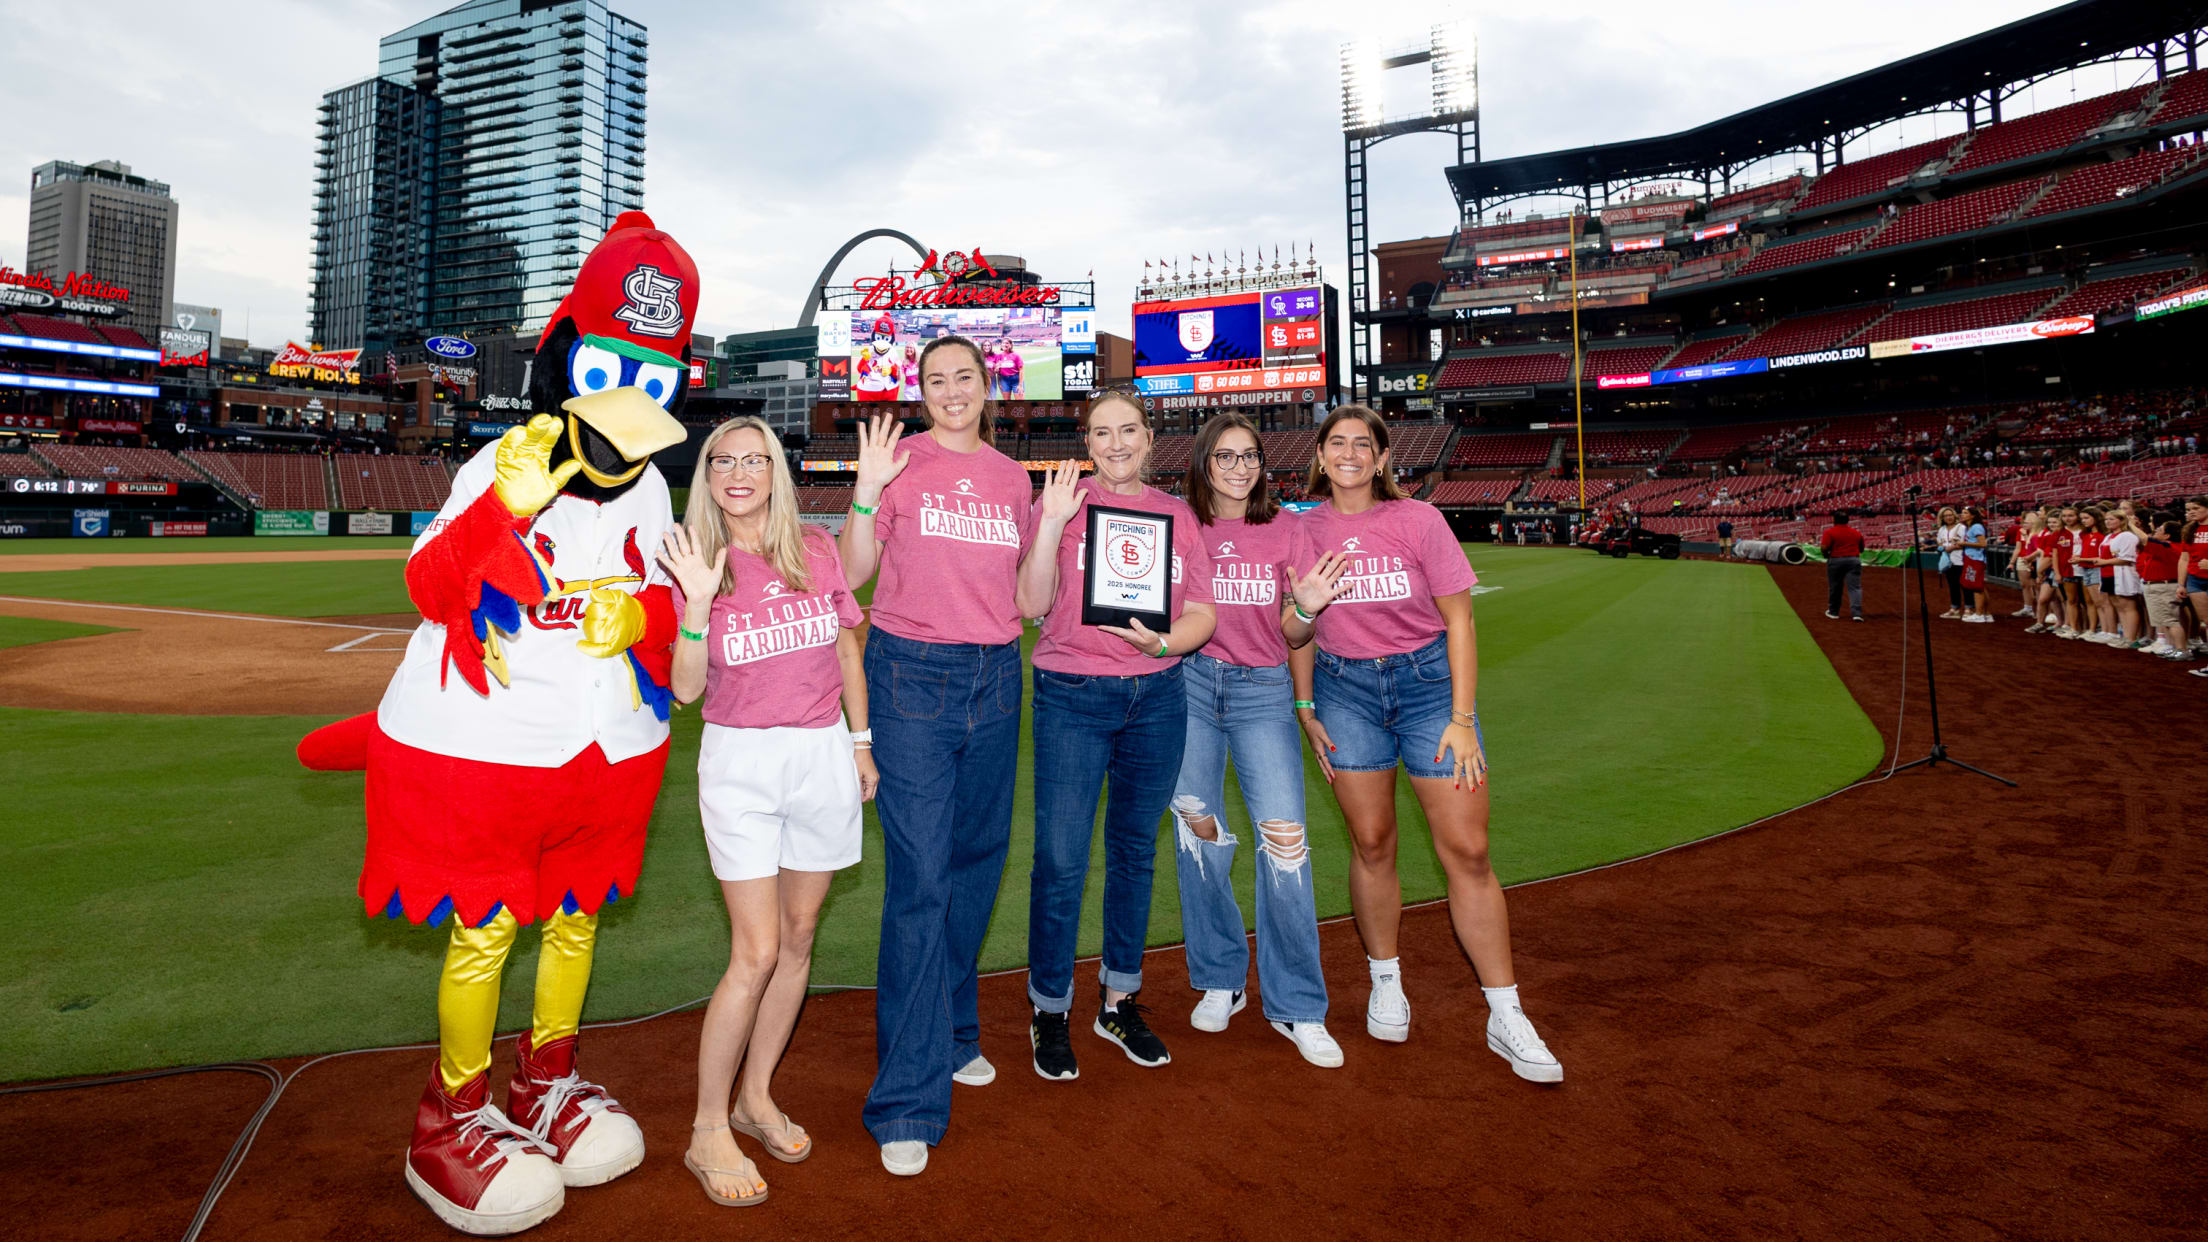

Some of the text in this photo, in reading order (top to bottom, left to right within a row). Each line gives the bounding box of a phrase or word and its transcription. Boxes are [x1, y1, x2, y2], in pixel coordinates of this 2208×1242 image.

[1630, 181, 1682, 193] BUDWEISER
[1637, 203, 1690, 215] BUDWEISER
[53, 272, 129, 301] Nation
[853, 276, 1060, 310] Budweiser
[1152, 272, 1303, 297] WORLD CHAMPIONS
[61, 300, 115, 315] ROOFTOP
[1472, 307, 1512, 317] @cardinals
[2138, 297, 2181, 316] TODAY'S
[160, 331, 209, 345] FANDUEL
[1935, 331, 1983, 343] DIERBERGS
[1984, 326, 2028, 338] DELIVERS
[436, 338, 467, 355] Ford
[160, 347, 209, 368] Live!
[274, 347, 360, 369] Budweiser
[1770, 346, 1866, 369] LINDENWOOD.EDU
[270, 363, 312, 381] BREW
[1064, 360, 1093, 380] stl
[1147, 379, 1181, 391] STIFEL
[1163, 391, 1292, 408] BROWN & CROUPPEN
[1032, 406, 1045, 418] 45
[1050, 406, 1064, 418] 85
[34, 482, 98, 493] 6:12 76°
[129, 484, 165, 492] PURINA
[74, 509, 109, 518] CarShield
[922, 492, 1013, 521] ST. LOUIS
[925, 510, 1018, 545] CARDINALS
[1110, 522, 1146, 535] PITCHING
[1216, 563, 1273, 579] LOUIS
[1107, 580, 1152, 591] 2025 HONOREE
[1336, 574, 1407, 601] DINALS
[727, 612, 765, 633] ST.
[767, 594, 834, 625] LOUIS
[727, 615, 838, 663] CARDINALS
